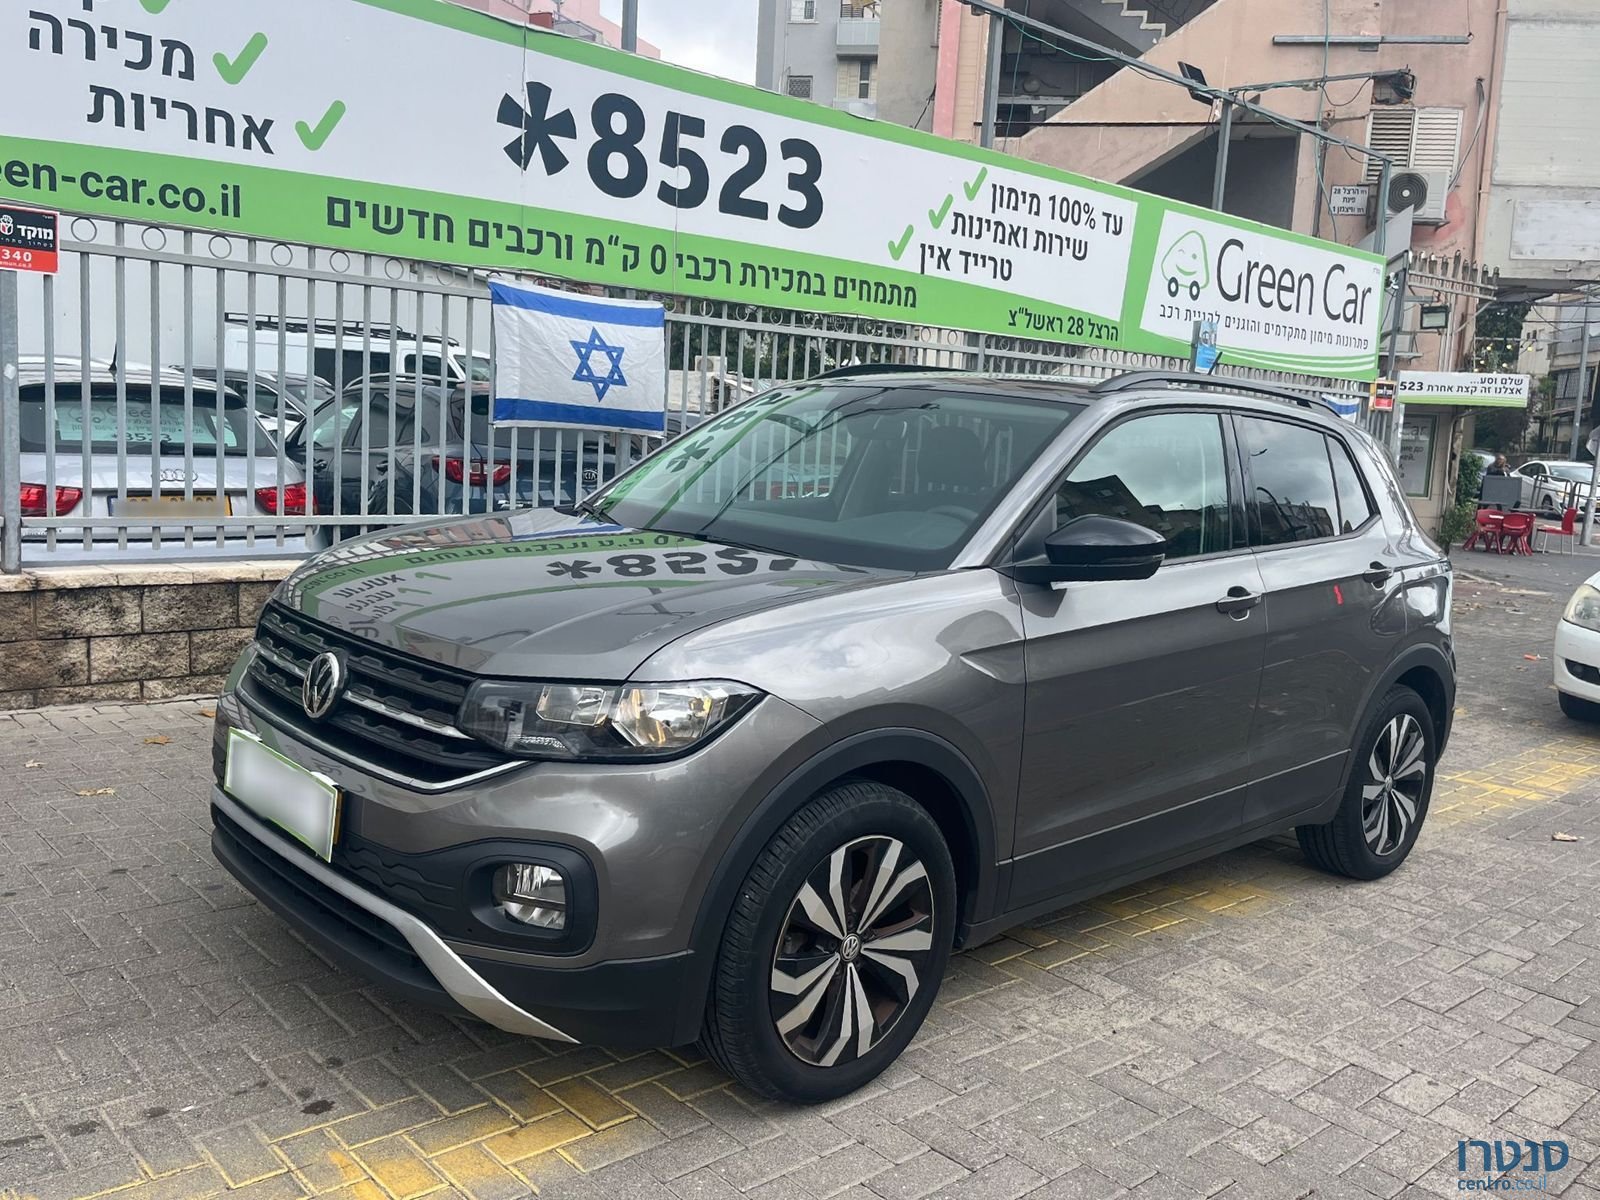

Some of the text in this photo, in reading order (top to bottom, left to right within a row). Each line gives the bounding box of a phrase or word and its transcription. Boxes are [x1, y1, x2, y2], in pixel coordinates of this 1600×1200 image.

[29, 10, 195, 82] מכירה
[87, 84, 275, 155] אחריות
[0, 159, 241, 218] en-car.co.il
[326, 196, 455, 244] חדשים
[991, 183, 1123, 236] עד 100% מימון
[16, 224, 54, 240] מוקד
[469, 218, 573, 261] ורכבים
[950, 211, 1089, 262] שירות ואמינות
[650, 244, 667, 275] 0
[676, 252, 731, 284] רכבי
[919, 243, 1013, 282] טרייד אין
[739, 261, 827, 297] במכירת
[834, 274, 917, 309] מתמחים
[1216, 238, 1372, 325] Green Car
[1067, 316, 1085, 337] 28
[1159, 304, 1180, 321] רכב
[1225, 315, 1261, 333] והוגנים
[1088, 318, 1119, 342] הרצל
[1264, 322, 1307, 342] מתקדמים
[1310, 330, 1333, 345] מימון
[1335, 333, 1369, 350] פתרונות
[1426, 384, 1522, 395] אצלנו זה קצת אחרת
[1500, 376, 1524, 386] שלם
